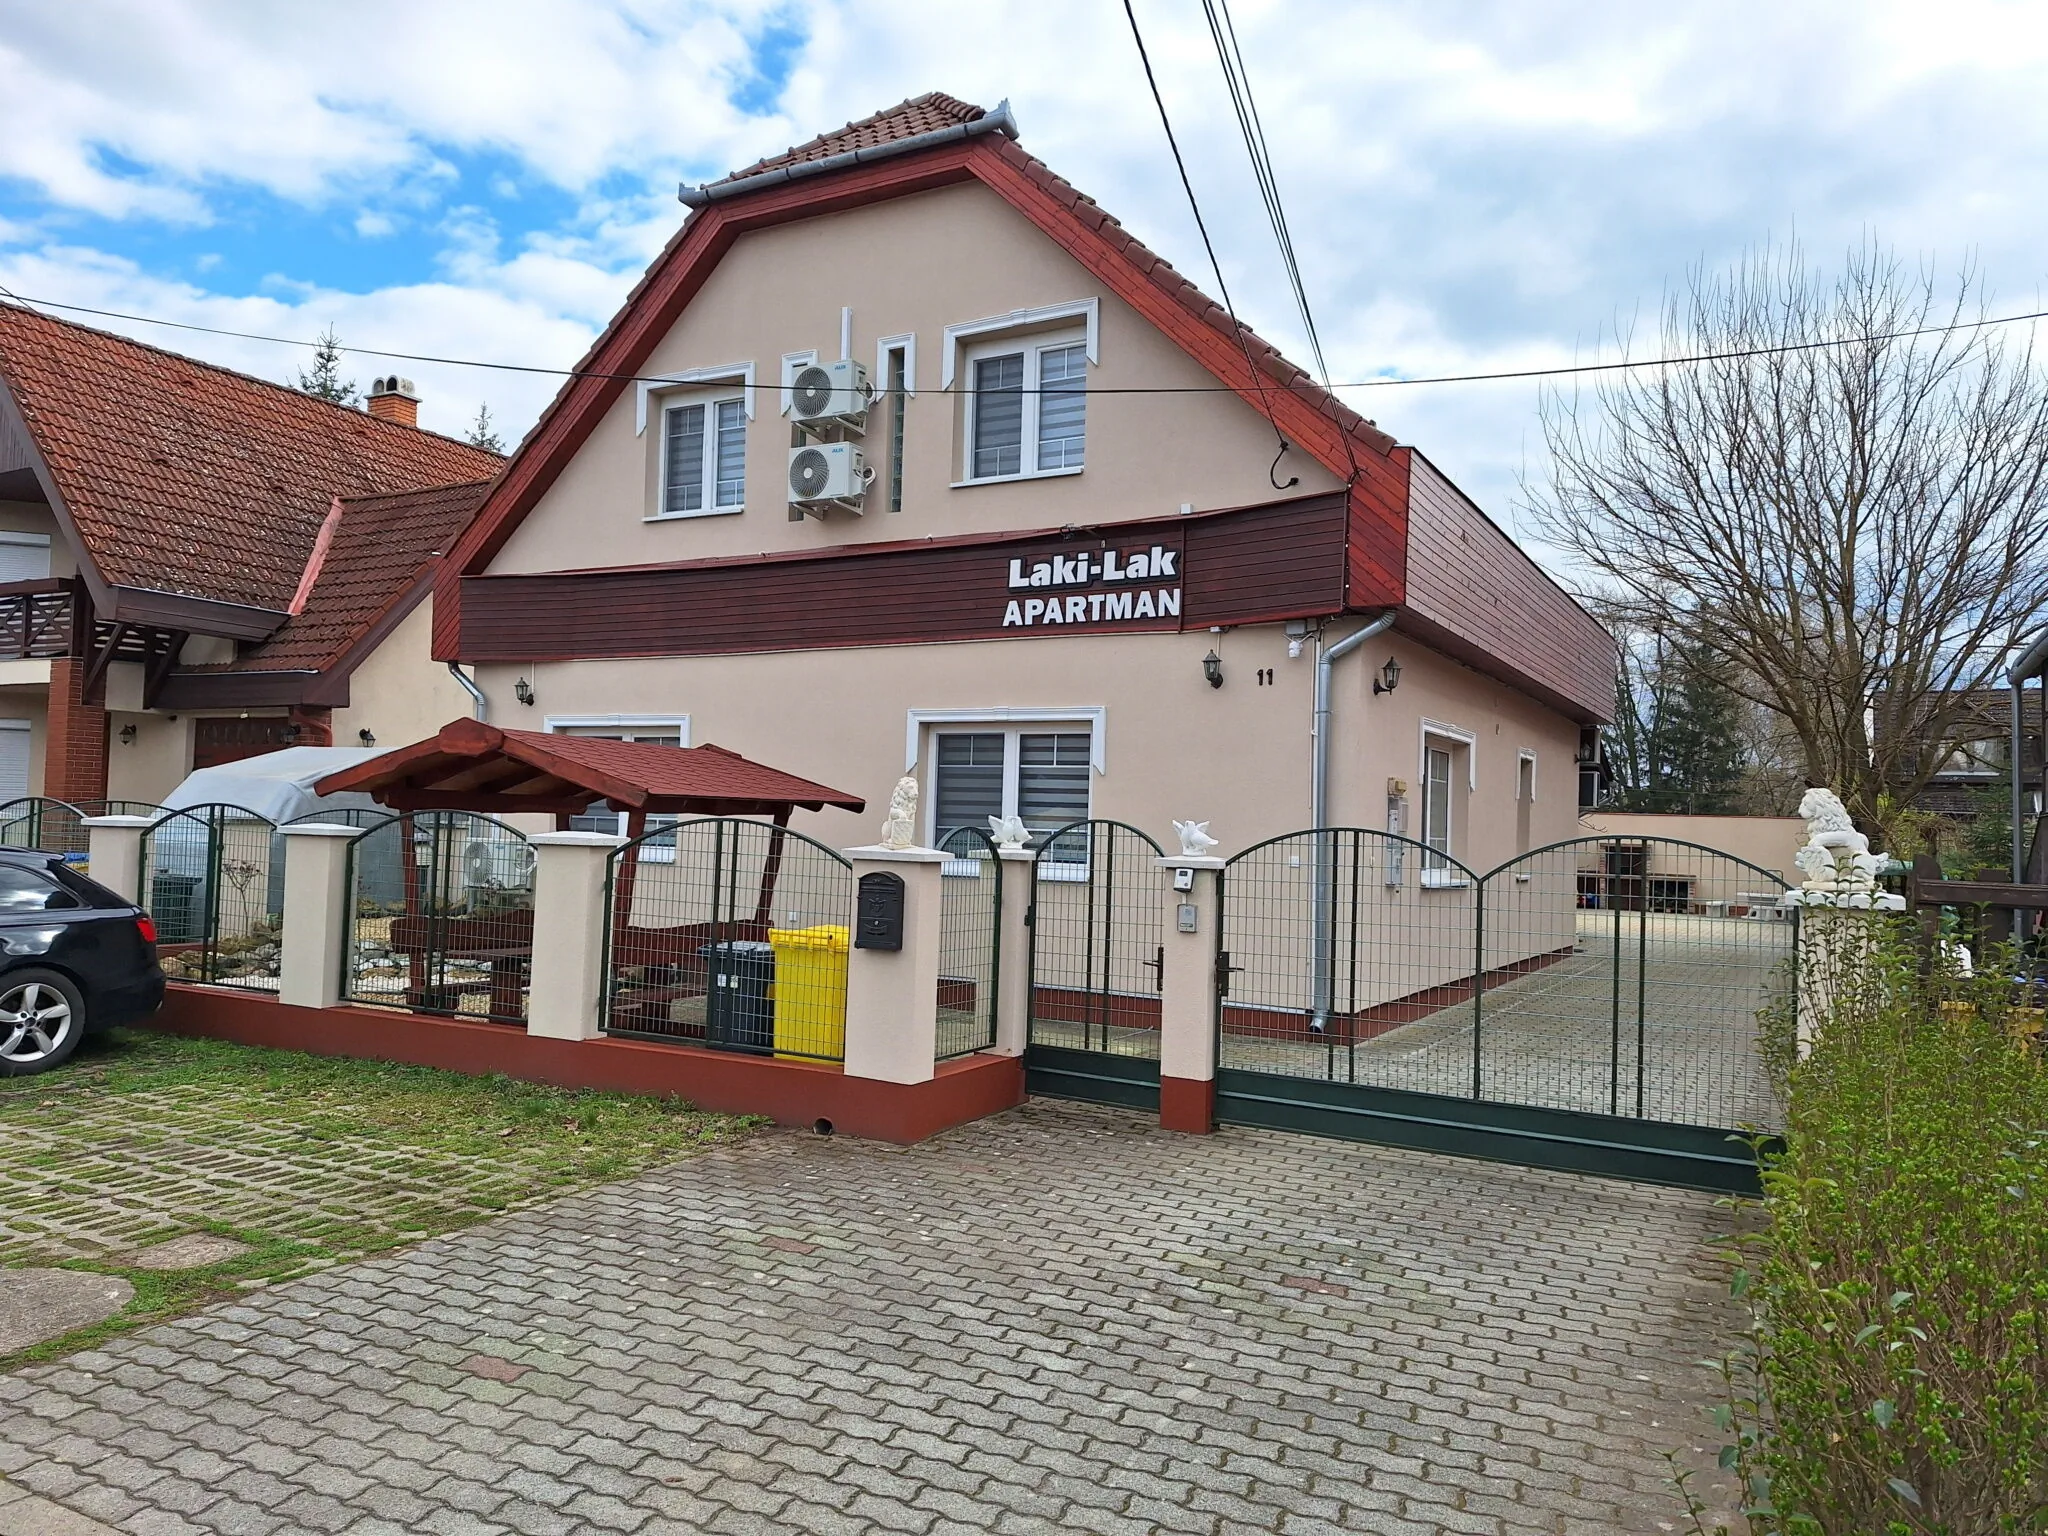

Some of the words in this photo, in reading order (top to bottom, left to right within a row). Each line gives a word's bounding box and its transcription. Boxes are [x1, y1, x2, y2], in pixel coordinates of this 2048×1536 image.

[1008, 546, 1177, 588] Laki-Lak
[1002, 588, 1181, 627] APARTMAN
[1256, 668, 1273, 686] 11
